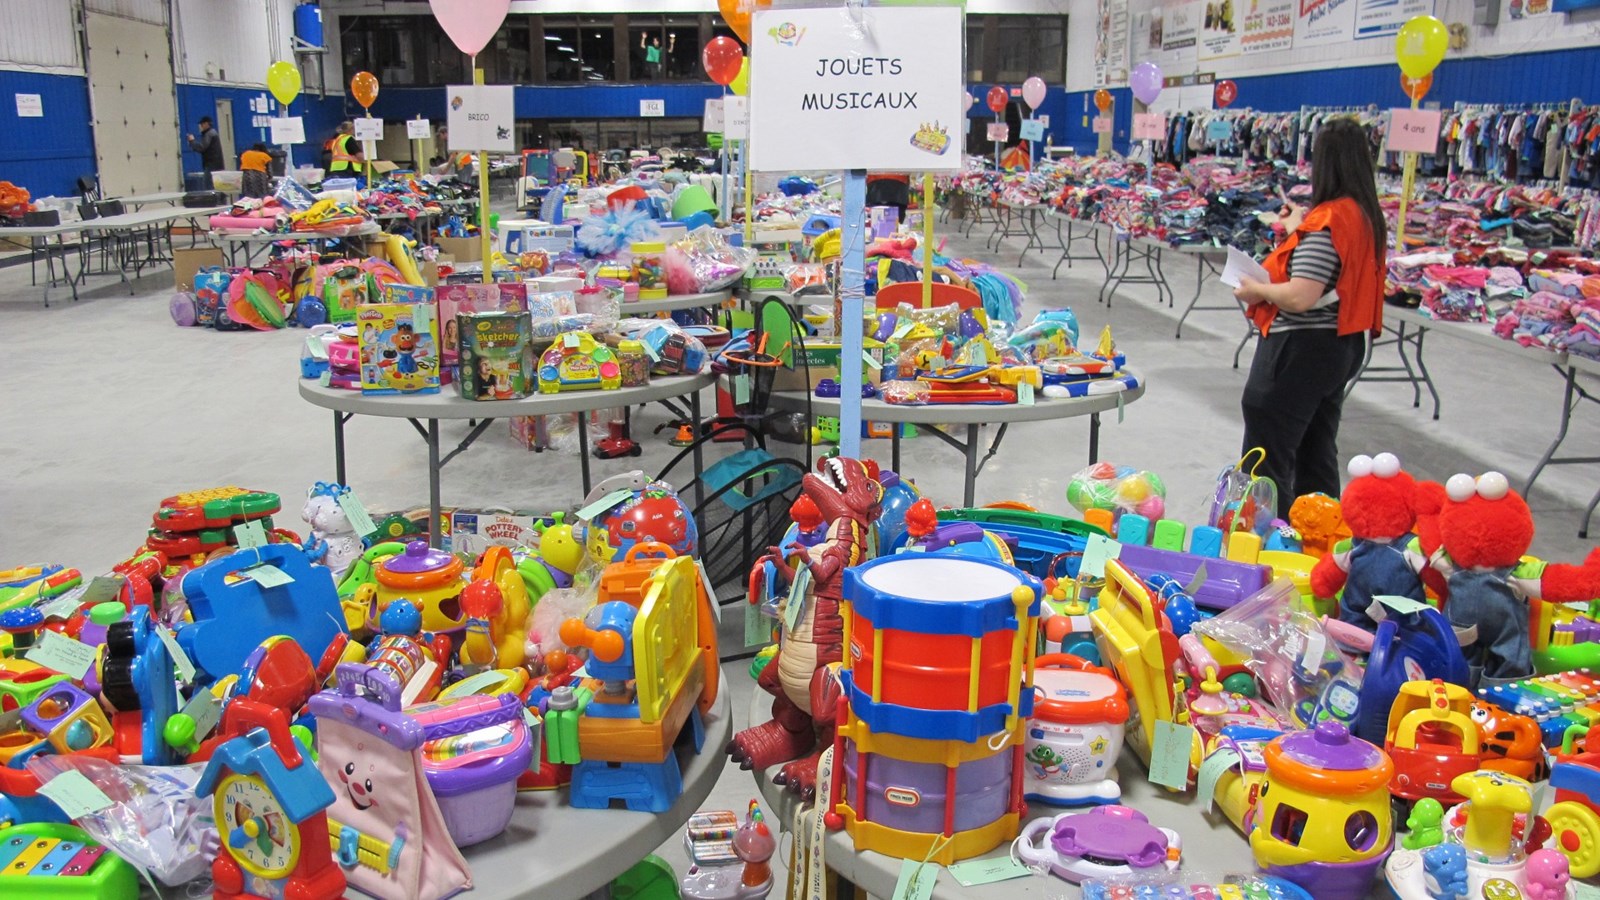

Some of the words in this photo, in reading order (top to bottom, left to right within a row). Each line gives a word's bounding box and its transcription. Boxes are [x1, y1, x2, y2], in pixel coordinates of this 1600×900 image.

[816, 57, 903, 77] JOUETS
[801, 92, 918, 111] MUSICAUX
[467, 113, 489, 121] BRICO
[1402, 123, 1408, 131] 4
[478, 332, 519, 341] sketcher
[484, 523, 524, 534] POTTERY
[234, 782, 244, 794] 11
[248, 781, 260, 792] 12
[226, 794, 236, 805] 10
[225, 812, 232, 822] 9
[248, 849, 254, 860] 7
[263, 857, 270, 868] 6
[278, 856, 285, 866] 5
